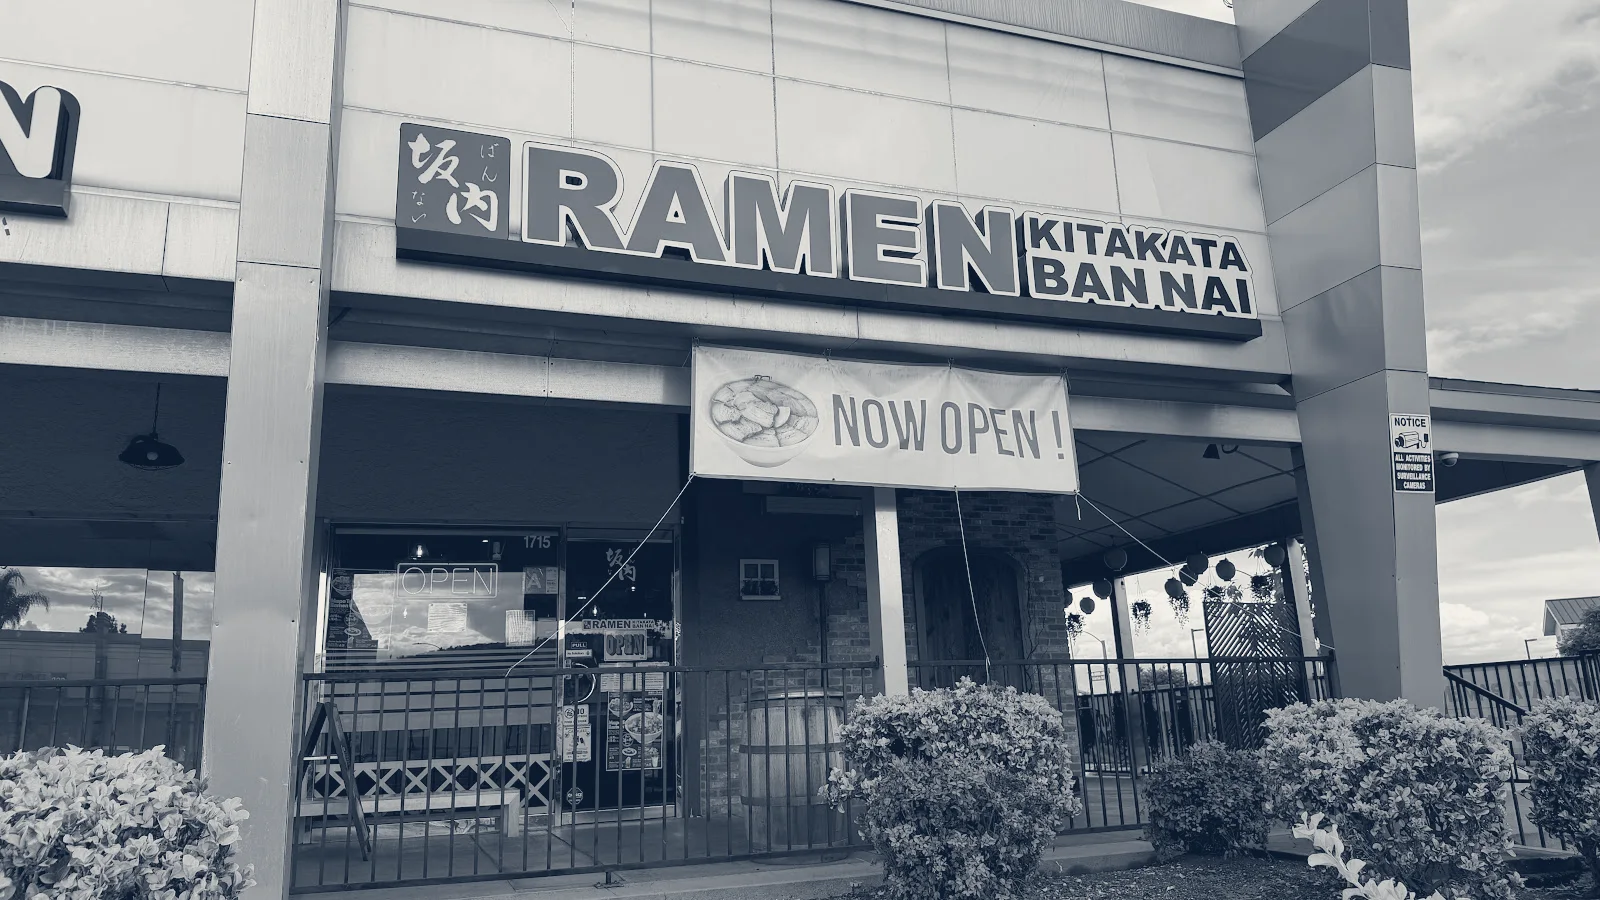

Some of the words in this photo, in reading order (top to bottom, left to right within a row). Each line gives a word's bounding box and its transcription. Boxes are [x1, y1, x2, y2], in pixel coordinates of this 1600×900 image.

[525, 145, 1018, 296] RAMEN
[1029, 216, 1248, 272] KITAKATA
[1032, 255, 1149, 304] BAN
[1160, 270, 1252, 314] NAI
[833, 393, 927, 452] NOW
[940, 400, 1041, 460] OPEN
[1394, 417, 1427, 428] NOTICE
[1395, 454, 1405, 462] ALL
[1406, 454, 1431, 463] ACTIVITIES
[1396, 463, 1423, 472] MONITORED
[1424, 464, 1431, 472] BY
[1397, 472, 1431, 481] SURVEILLANCE
[1403, 481, 1426, 490] CAMERAS
[524, 535, 551, 549] 1715
[402, 567, 493, 595] OPEN
[592, 620, 631, 629] RAMEN
[606, 634, 645, 656] OPEN
